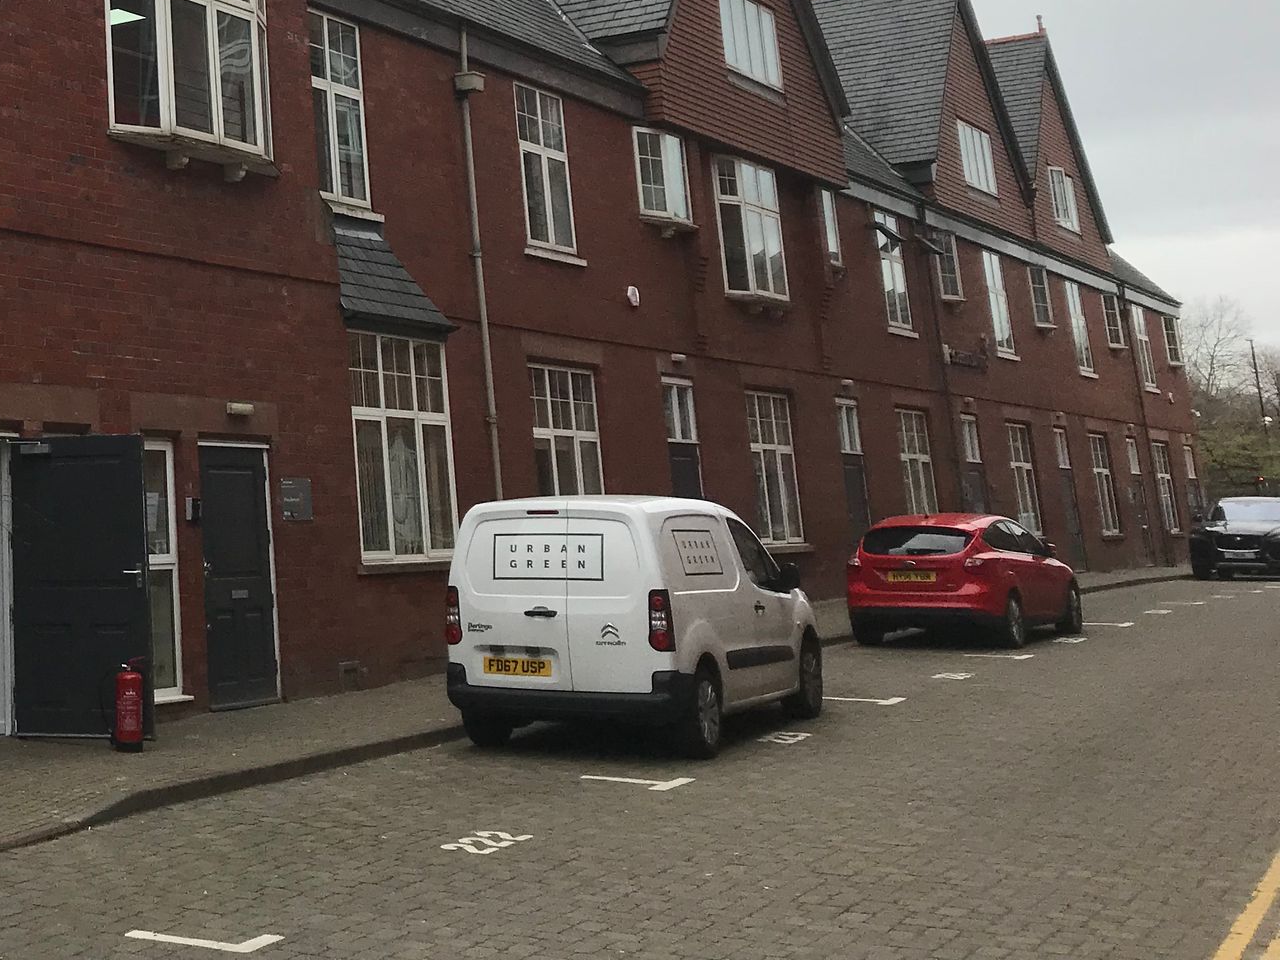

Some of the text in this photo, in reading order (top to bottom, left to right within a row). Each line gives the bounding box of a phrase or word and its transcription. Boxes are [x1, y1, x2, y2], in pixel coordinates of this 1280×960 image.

[509, 544, 586, 554] URBAN
[509, 559, 586, 569] GREEN
[686, 555, 715, 565] GREEN
[488, 659, 546, 674] FD67 USP
